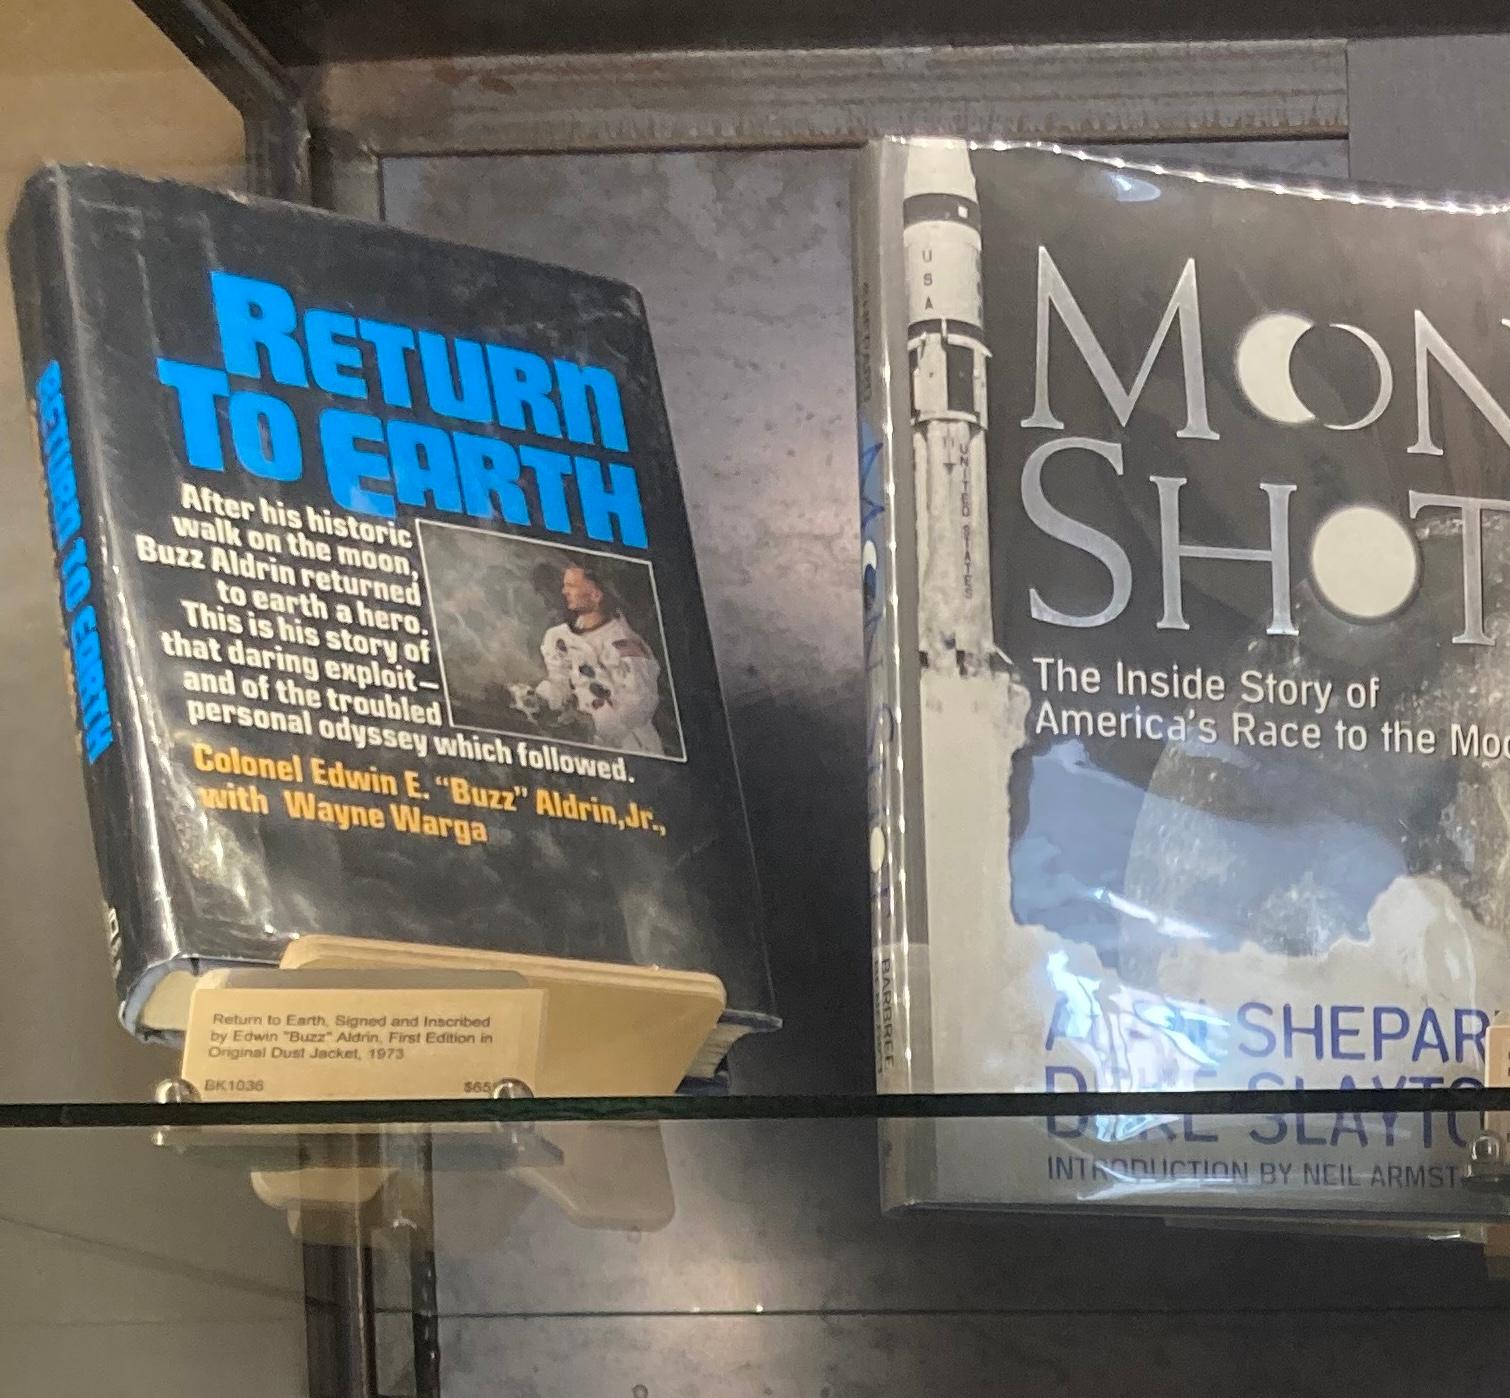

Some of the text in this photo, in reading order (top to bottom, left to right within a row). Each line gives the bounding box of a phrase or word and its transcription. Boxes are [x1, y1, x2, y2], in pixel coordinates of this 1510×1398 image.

[158, 359, 648, 549] TO EARTH
[180, 482, 413, 549] After historic
[135, 534, 421, 606] Buzz Aldrin returned
[172, 516, 419, 580] walk moon,
[181, 600, 398, 664] This story
[252, 590, 428, 635] earth hero.
[159, 630, 319, 681] that daring
[327, 689, 442, 726] troubled
[1116, 660, 1332, 713] Inside Story
[187, 699, 635, 783] personal odyssey which followed.
[1034, 701, 1218, 744] America's
[1232, 712, 1321, 750] Race
[192, 743, 397, 796] Colonel Edwin
[199, 785, 487, 846] with Wayne Warga
[213, 1014, 490, 1028] Return Earth, Signed Inscribed
[234, 1030, 475, 1044] Edwin "Buzz" Aldrin, First Edition
[208, 1047, 404, 1061] Original Dust Jacket, 1973
[204, 1080, 264, 1092] BK1036
[1047, 1156, 1360, 1187] INTRODUCTION NEIL
